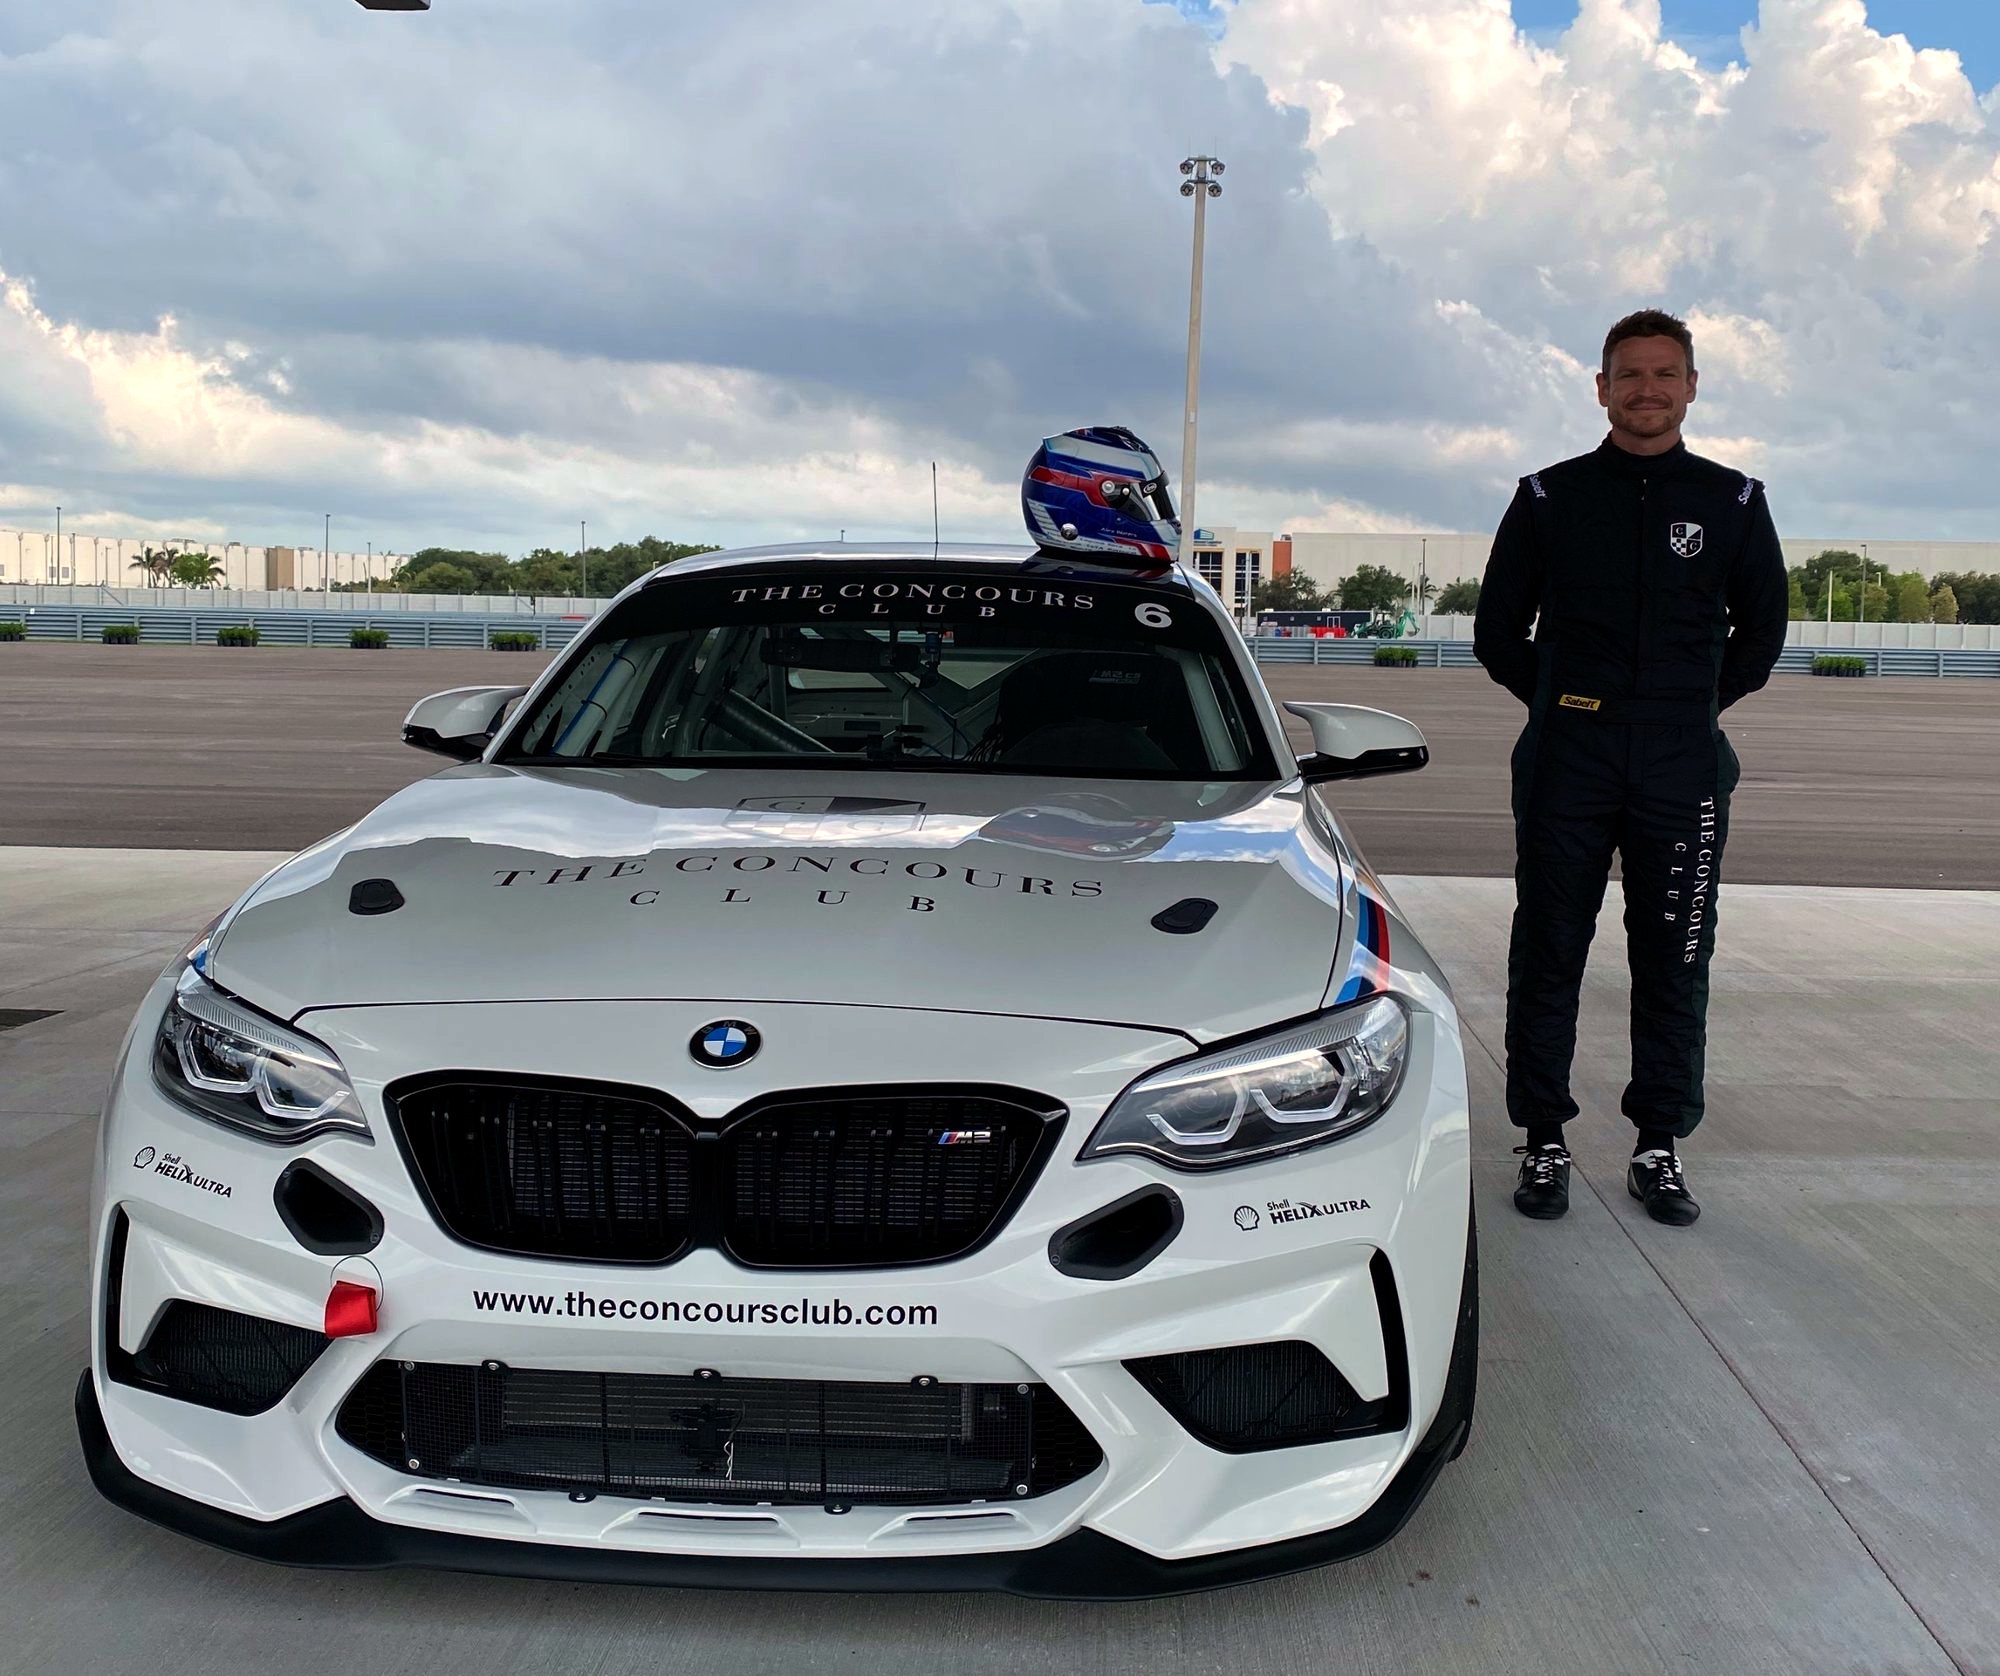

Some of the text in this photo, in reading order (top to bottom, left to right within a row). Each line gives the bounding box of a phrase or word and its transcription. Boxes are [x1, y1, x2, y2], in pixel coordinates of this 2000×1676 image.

[1675, 527, 1684, 536] C
[1689, 541, 1698, 551] C
[732, 583, 1094, 609] THE CONCOURS
[1134, 602, 1172, 628] 6
[1563, 696, 1597, 709] Sabelt
[493, 855, 1103, 898] THE CONCOURS
[1684, 797, 1715, 963] THE CONCOURS
[162, 1153, 181, 1164] Shell
[154, 1162, 232, 1198] HELIX ULTRA
[1267, 1199, 1290, 1211] Shell
[1269, 1199, 1371, 1225] HELIX ULTRA
[473, 1290, 938, 1326] www.theconcoursclub.com
